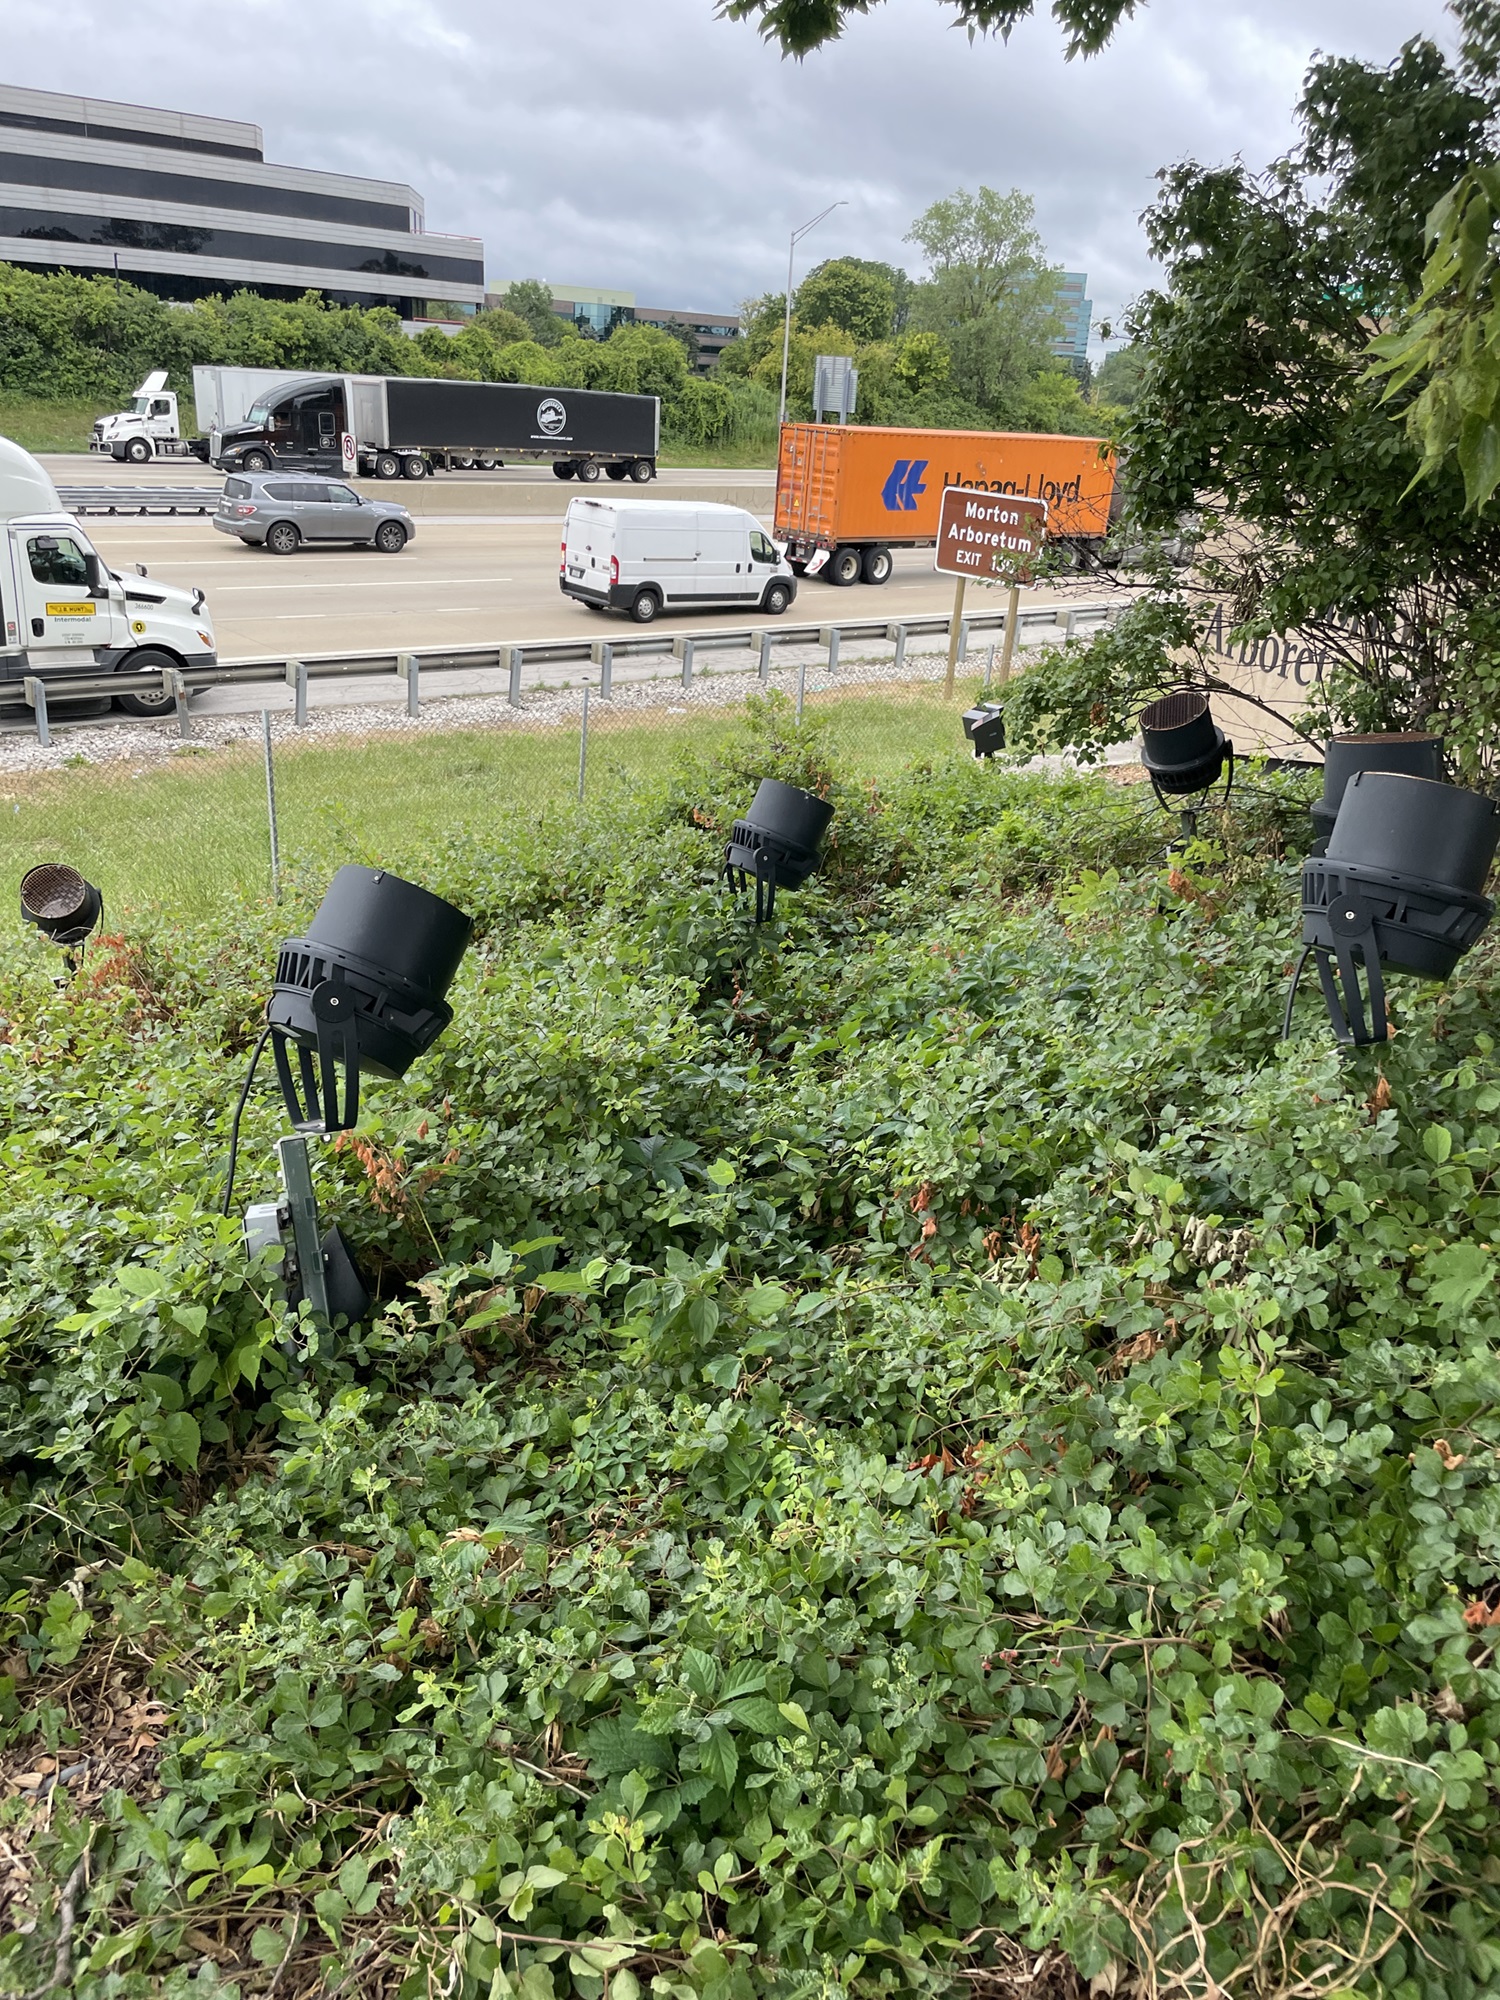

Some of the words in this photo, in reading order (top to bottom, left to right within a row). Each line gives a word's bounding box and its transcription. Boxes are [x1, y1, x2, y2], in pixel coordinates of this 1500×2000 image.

[965, 501, 1019, 526] Morton
[948, 523, 1031, 553] Arboretum
[956, 550, 982, 567] EXIT
